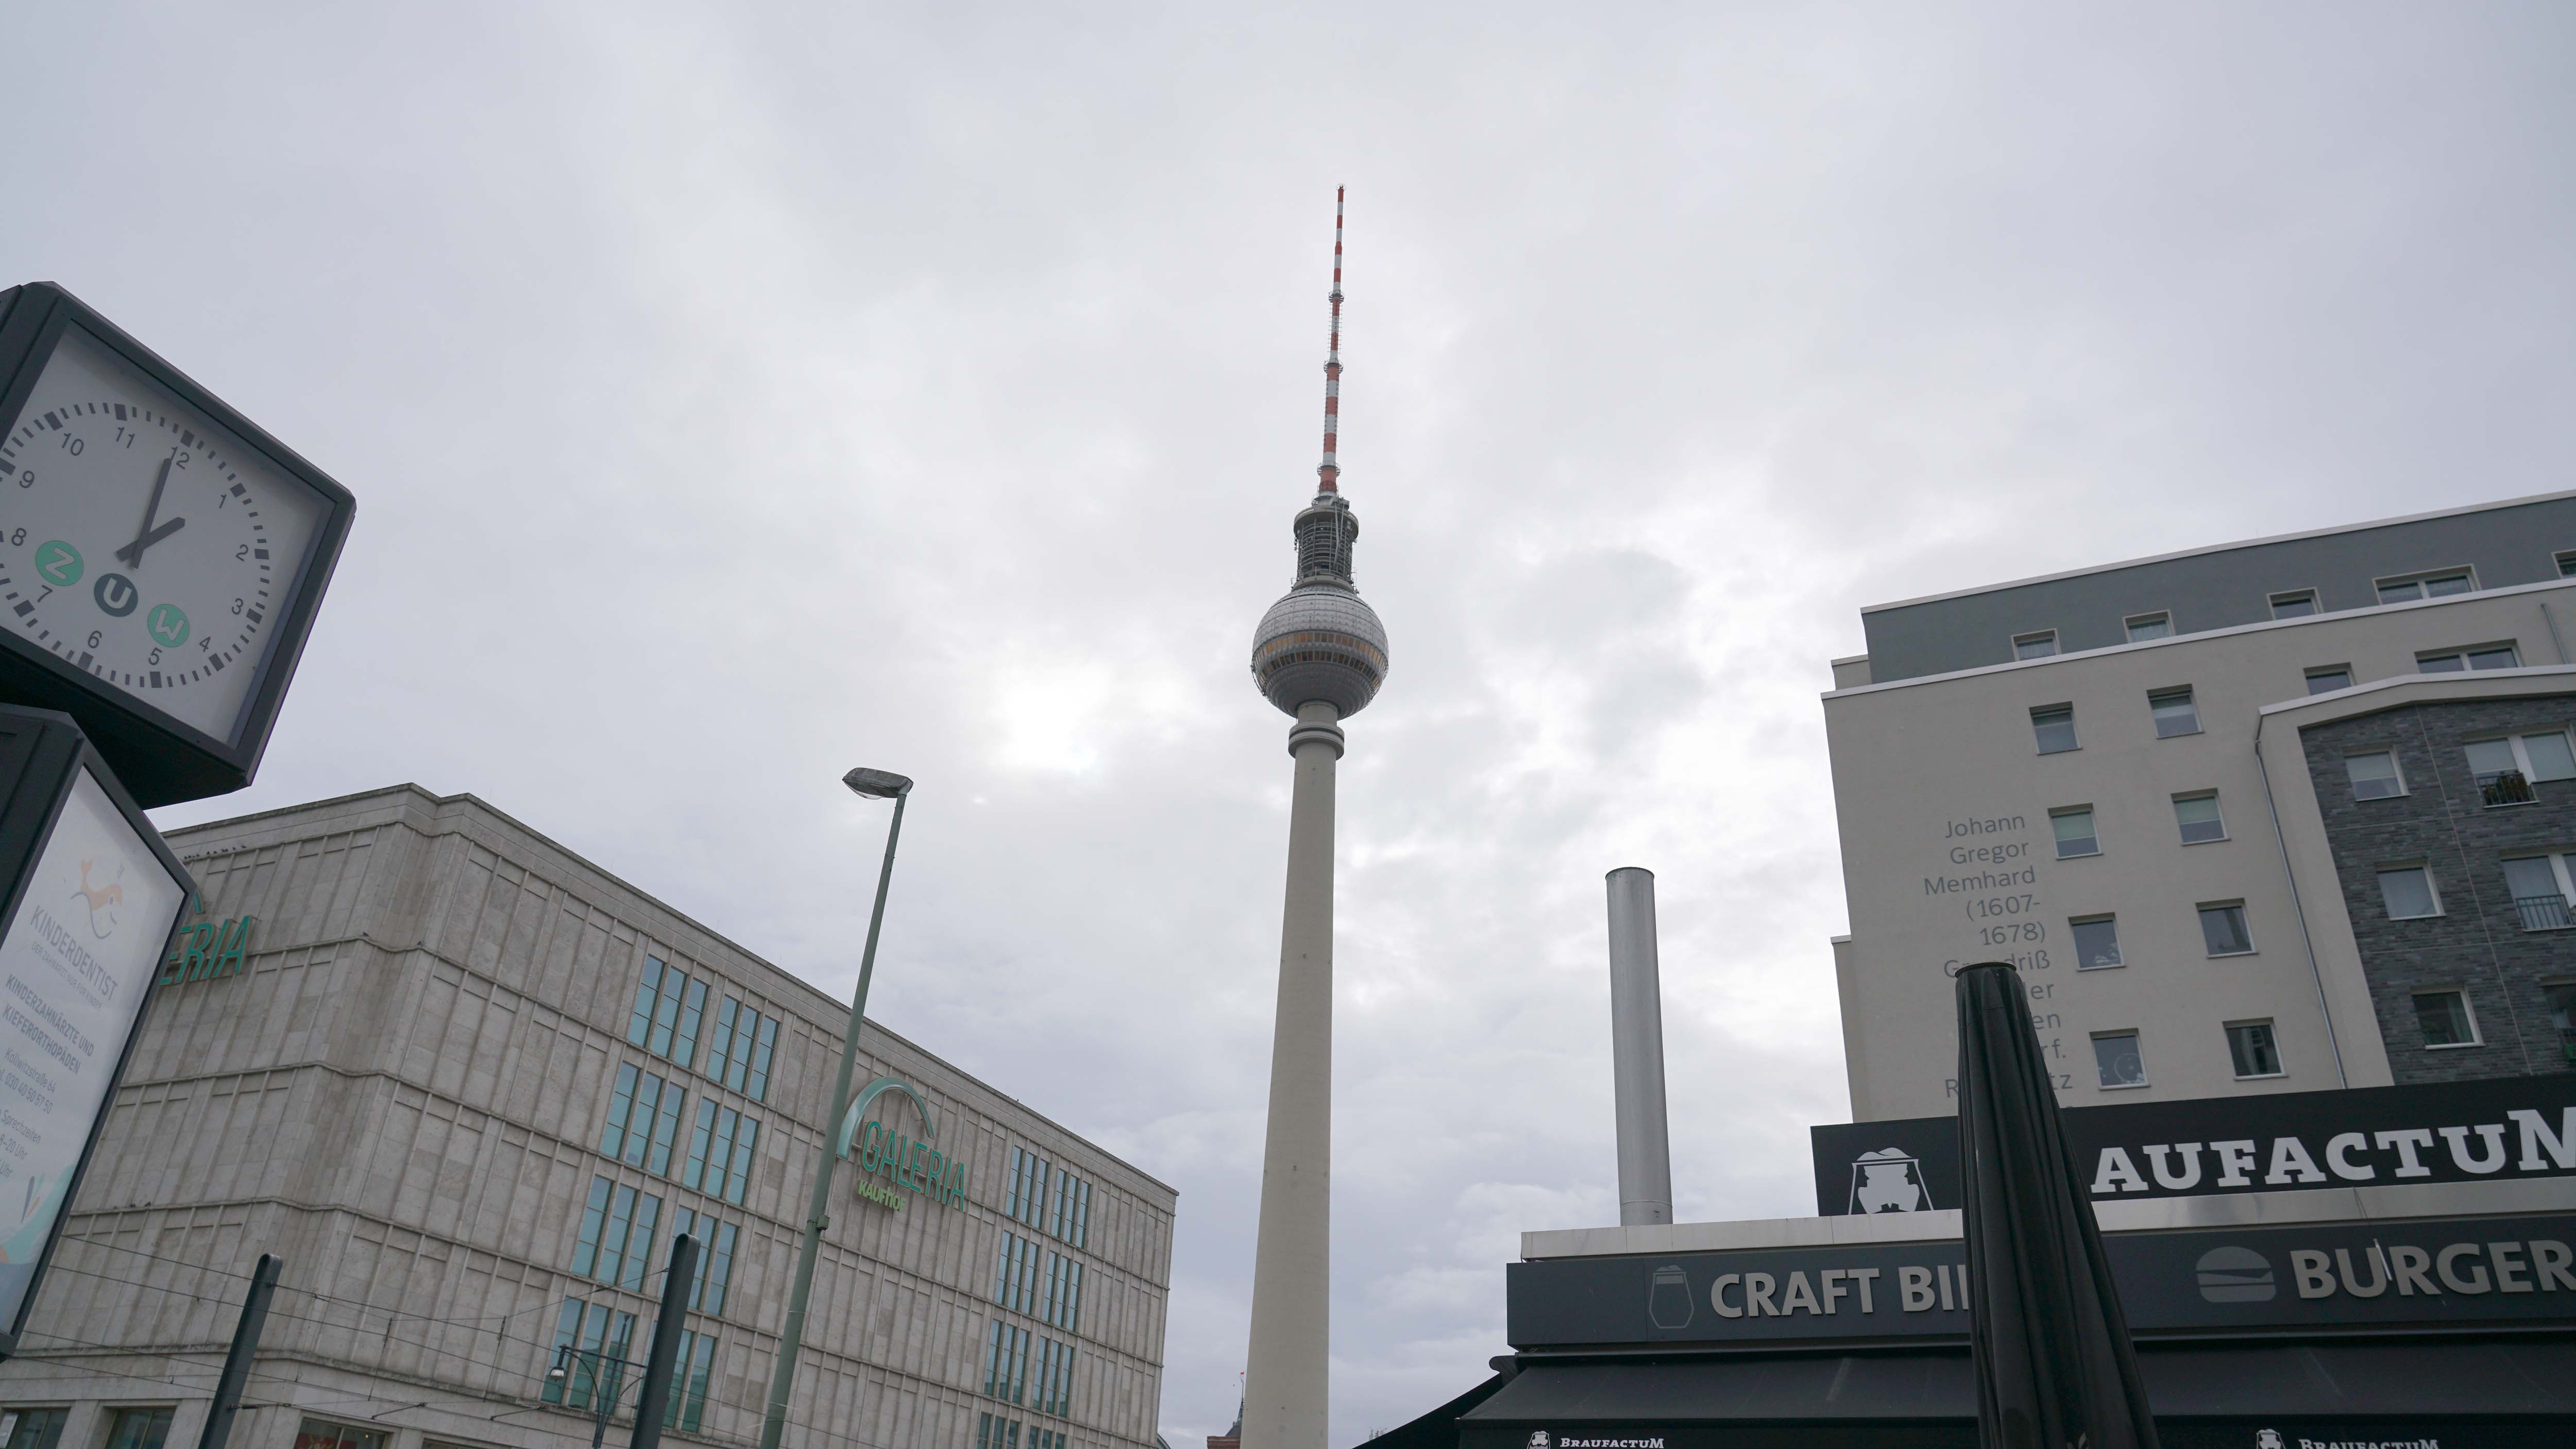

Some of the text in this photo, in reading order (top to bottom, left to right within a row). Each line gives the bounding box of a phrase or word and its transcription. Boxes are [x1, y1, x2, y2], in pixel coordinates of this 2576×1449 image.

[62, 432, 84, 456] 10
[115, 427, 135, 449] 11
[171, 446, 190, 470] 12
[19, 470, 35, 488] 9
[219, 494, 227, 509] 1
[11, 528, 27, 547] 8
[235, 544, 248, 562] 2
[45, 546, 76, 581] Z
[104, 576, 133, 609] U
[38, 584, 53, 602] 7
[231, 598, 243, 615] 3
[88, 630, 103, 649] 6
[199, 637, 211, 652] 4
[148, 647, 162, 666] 5
[1945, 816, 2025, 838] Johann
[1950, 843, 2029, 864] Gregor
[1924, 865, 2036, 895] Memhard
[1967, 894, 2040, 922] (1607-
[1979, 921, 2045, 946] 1678)
[30, 904, 118, 1001] KINDERDENTIST
[160, 915, 251, 985] RIA
[1944, 950, 2050, 978] Gdriß
[6, 973, 94, 1056] KINDERZAHNÄRZTE UND
[3, 1004, 81, 1074] KIEFERORTHOPÄDEN
[5, 1047, 48, 1087] Kollwitzstraße
[5, 1072, 20, 1090] 030
[26, 1087, 37, 1102] 50
[35, 1093, 45, 1108] 57
[43, 1100, 53, 1114] 50
[1, 1109, 41, 1144] Sprechzeiten
[14, 1144, 28, 1160] Uhr
[2090, 1106, 2576, 1194] AUFACTUM
[0, 1162, 13, 1178] Uhr
[861, 1120, 964, 1212] GALERIA
[2289, 1239, 2576, 1300] BURGER
[1710, 1268, 1880, 1319] CRAFT
[1560, 1437, 1664, 1448] BRAUFACTUM
